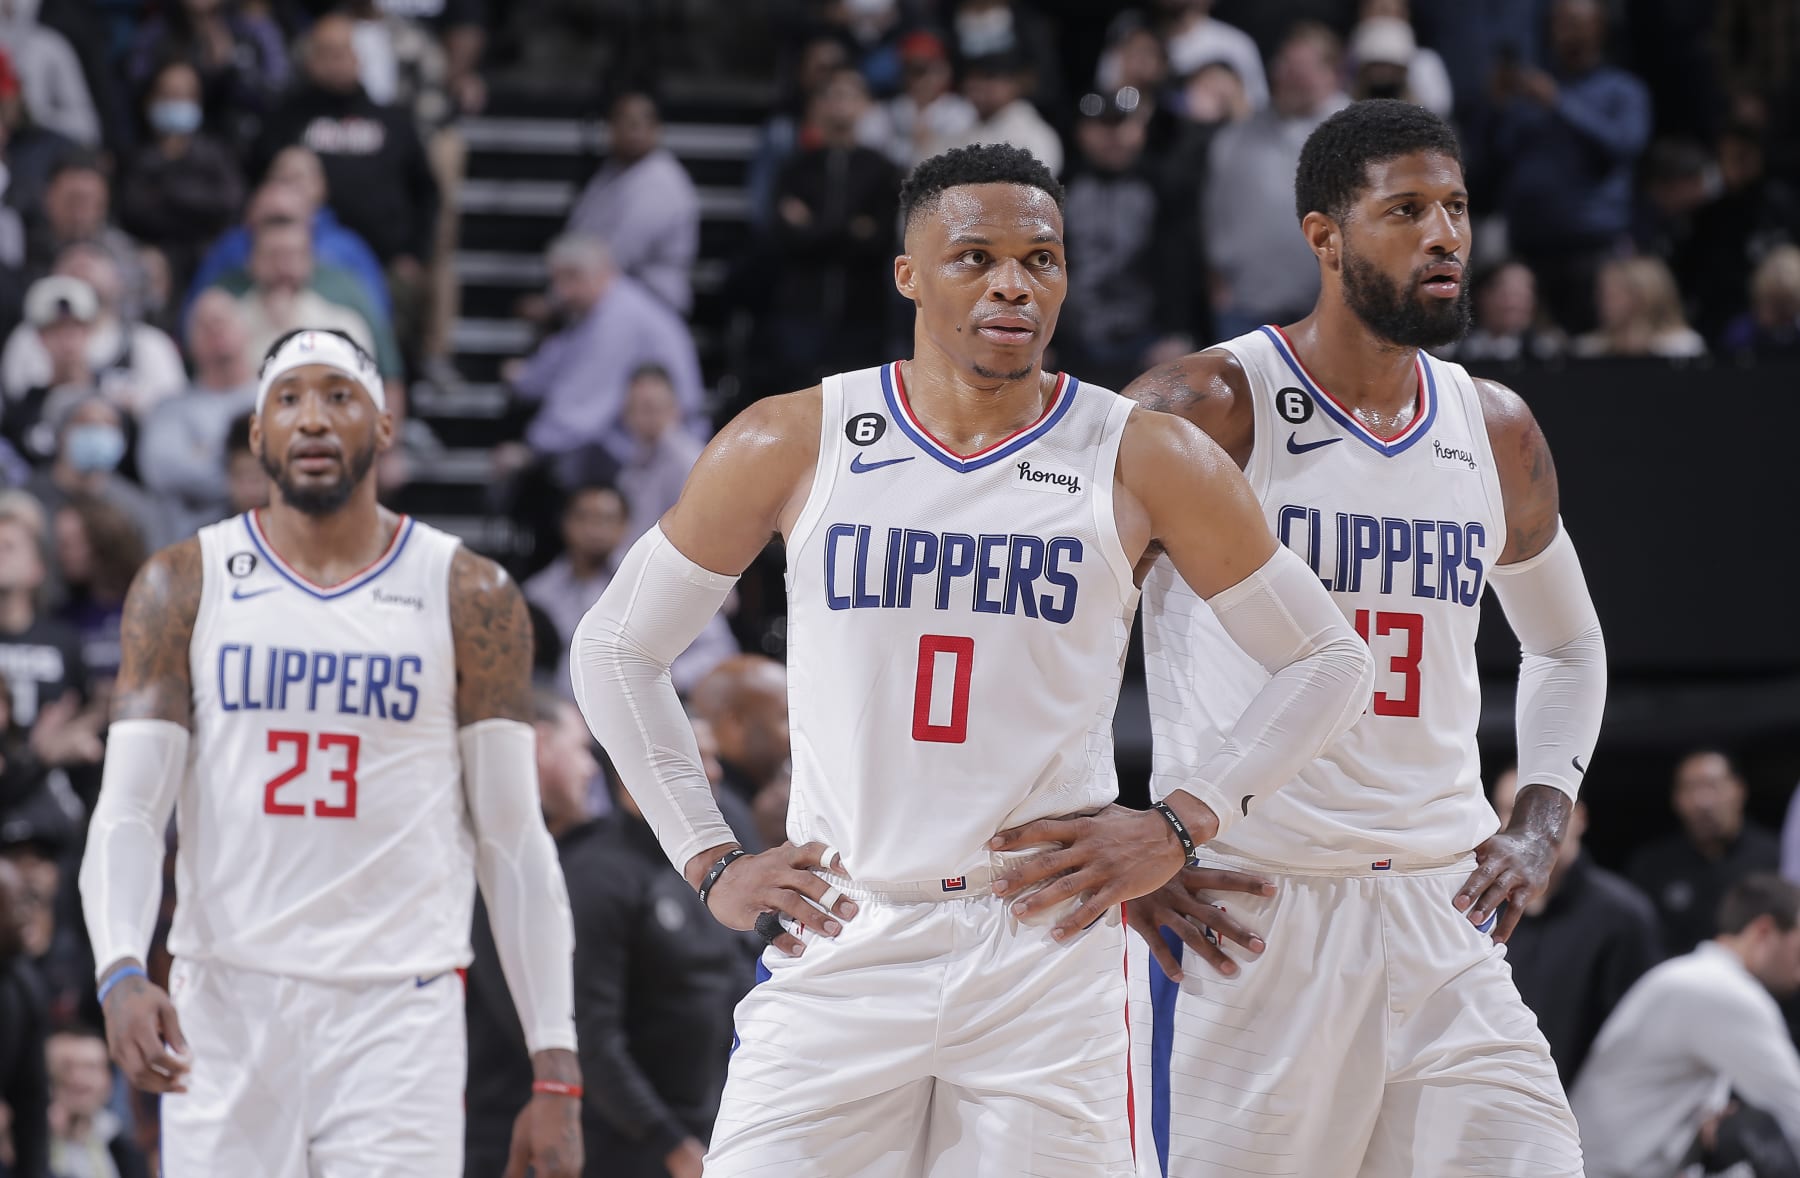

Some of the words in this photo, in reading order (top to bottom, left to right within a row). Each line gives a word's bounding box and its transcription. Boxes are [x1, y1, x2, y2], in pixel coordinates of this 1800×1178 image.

[1284, 393, 1305, 418] 6
[854, 417, 877, 442] 6
[1433, 440, 1477, 469] honey
[1017, 461, 1081, 493] honey
[231, 553, 252, 576] 6
[824, 523, 1084, 624] CLIPPERS
[217, 643, 422, 722] CLIPPERS
[911, 634, 975, 744] 0
[264, 729, 361, 819] 23
